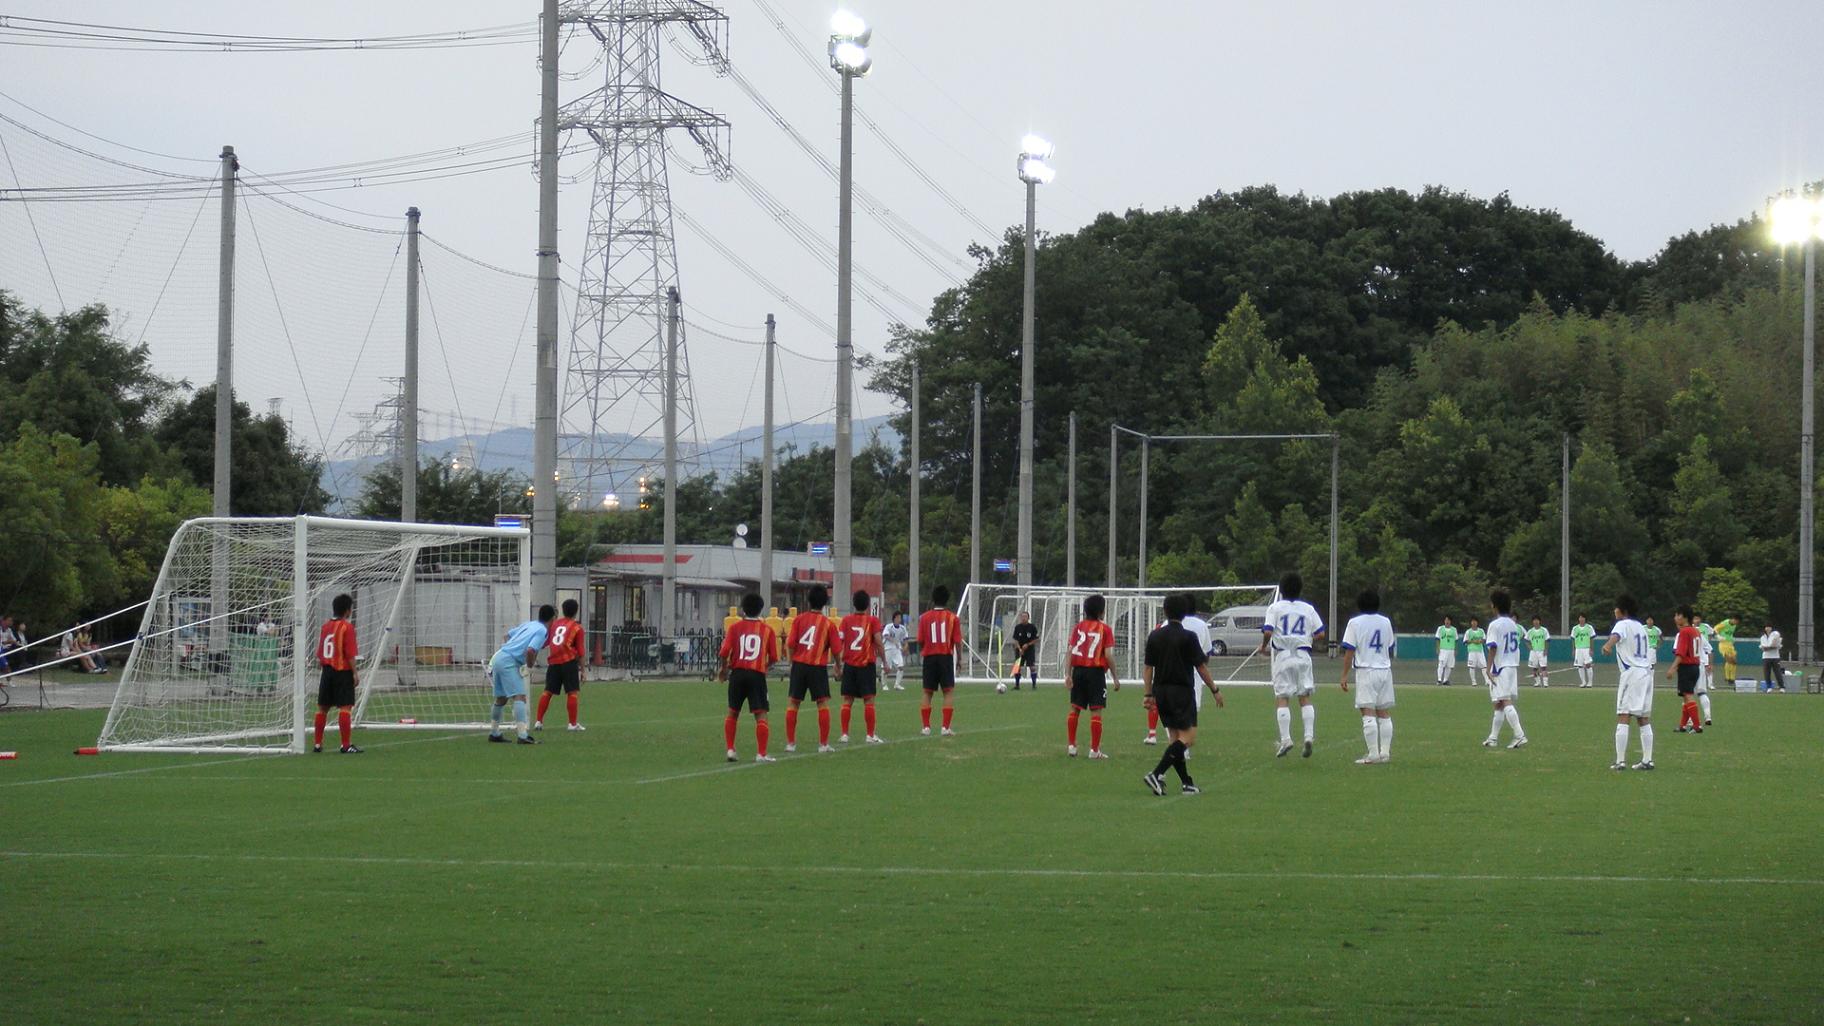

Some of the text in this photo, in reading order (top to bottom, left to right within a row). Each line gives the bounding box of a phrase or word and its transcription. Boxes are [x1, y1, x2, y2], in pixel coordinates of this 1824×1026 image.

[552, 626, 567, 646] 8
[931, 621, 946, 643] 11
[1281, 614, 1306, 635] 14
[323, 633, 336, 659] 6
[739, 634, 761, 661] 19
[799, 625, 816, 650] 4
[850, 626, 865, 650] 2
[1071, 629, 1101, 658] 27
[1369, 629, 1384, 654] 4
[1503, 630, 1518, 654] 15
[1633, 633, 1648, 659] 11
